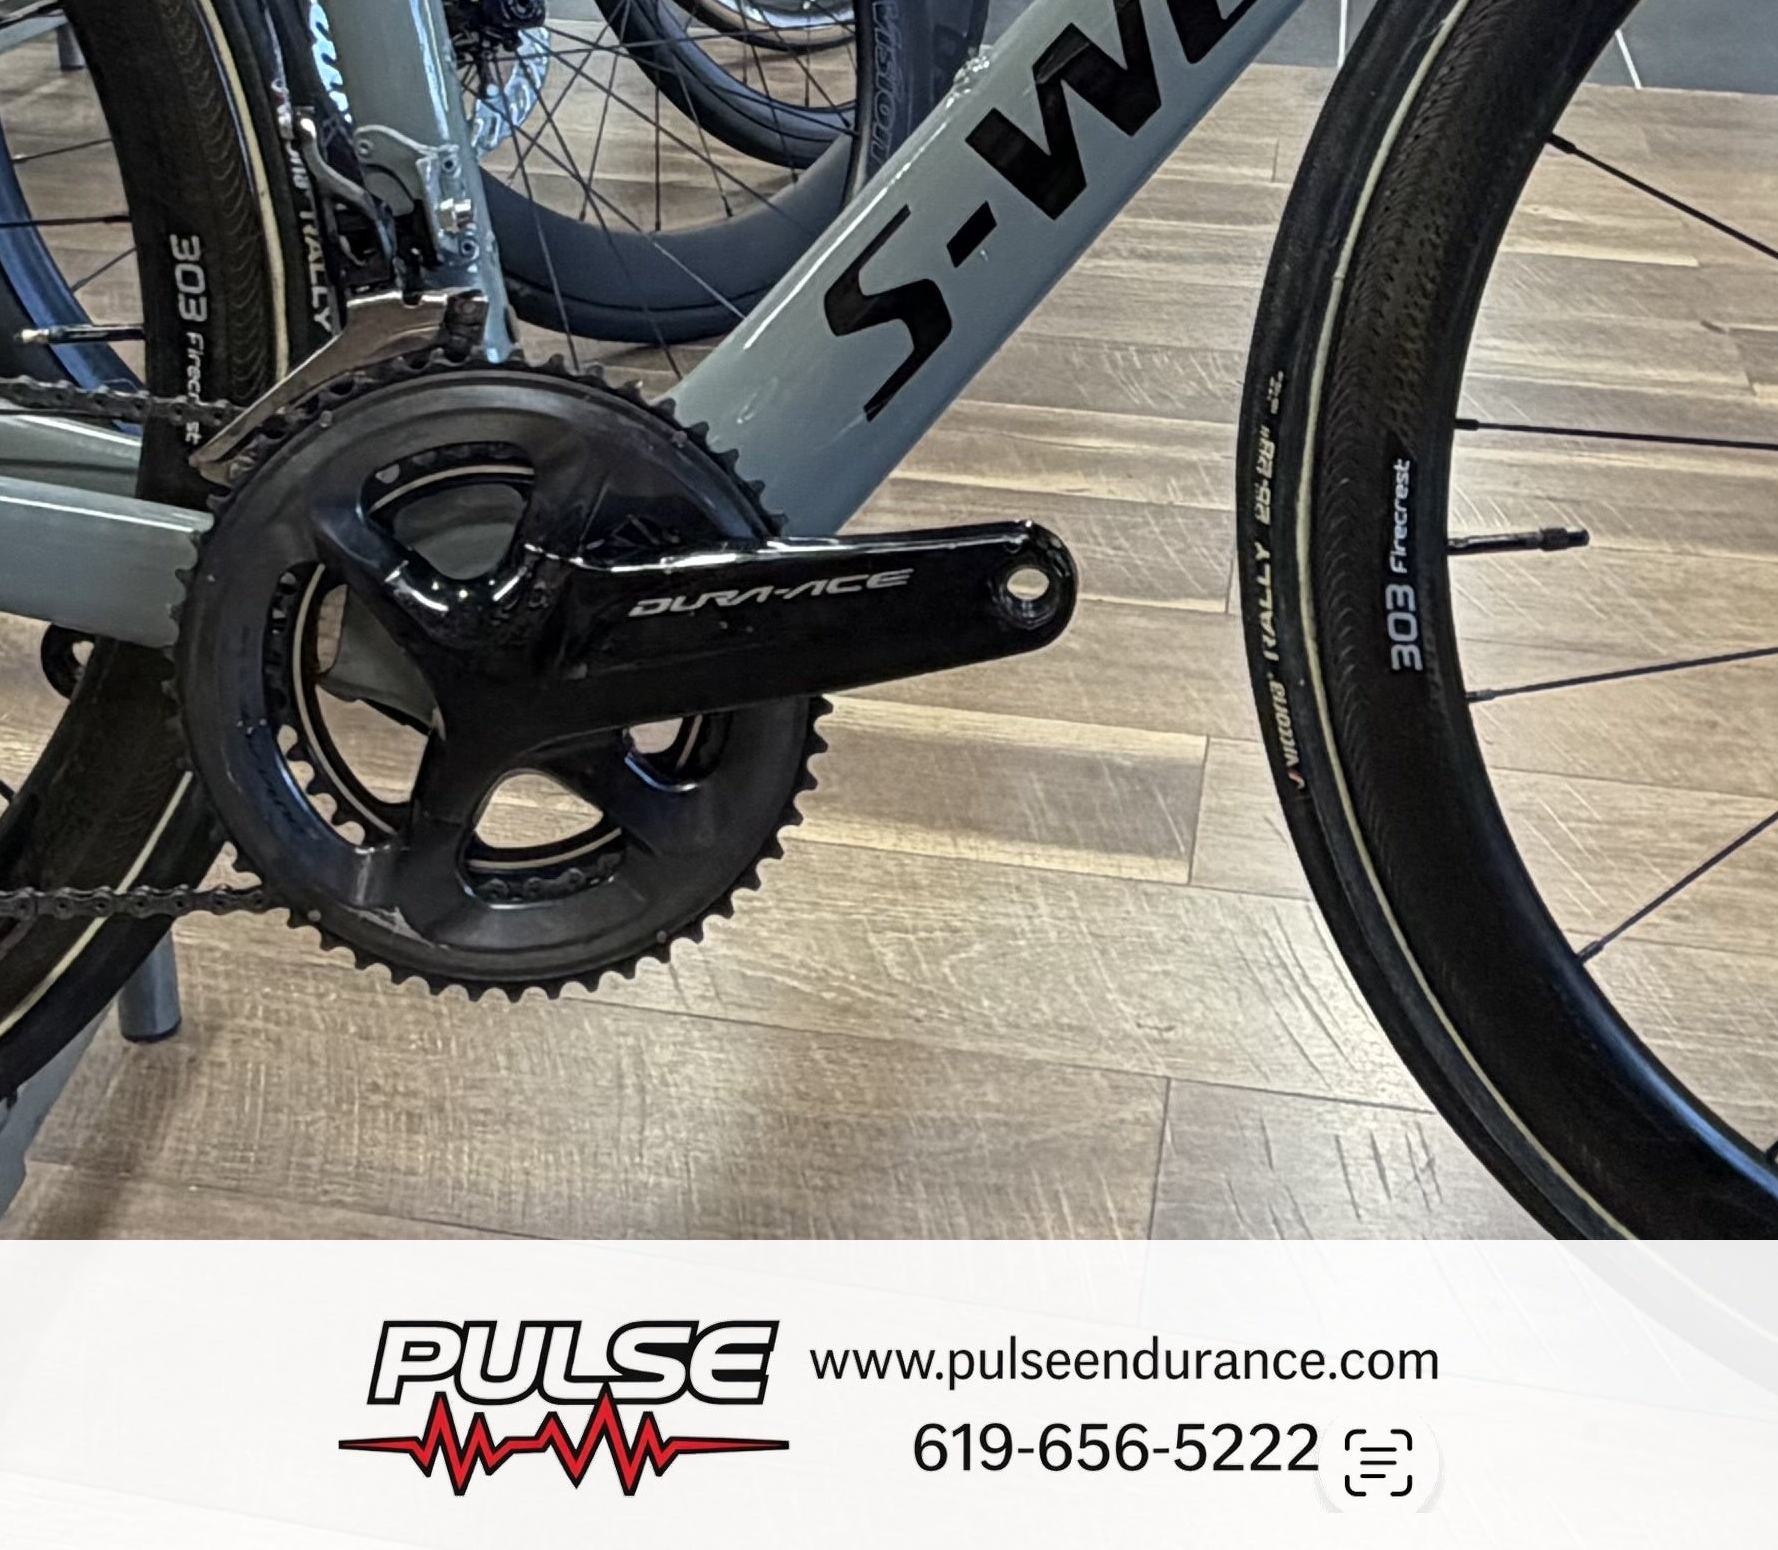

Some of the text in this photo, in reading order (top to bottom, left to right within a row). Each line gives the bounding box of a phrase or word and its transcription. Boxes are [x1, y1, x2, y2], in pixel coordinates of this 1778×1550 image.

[169, 233, 208, 445] 303 Firecrst
[628, 567, 915, 618] DURA-ACE
[1254, 541, 1281, 662] RALLY
[1384, 457, 1423, 672] 303 Firecrest
